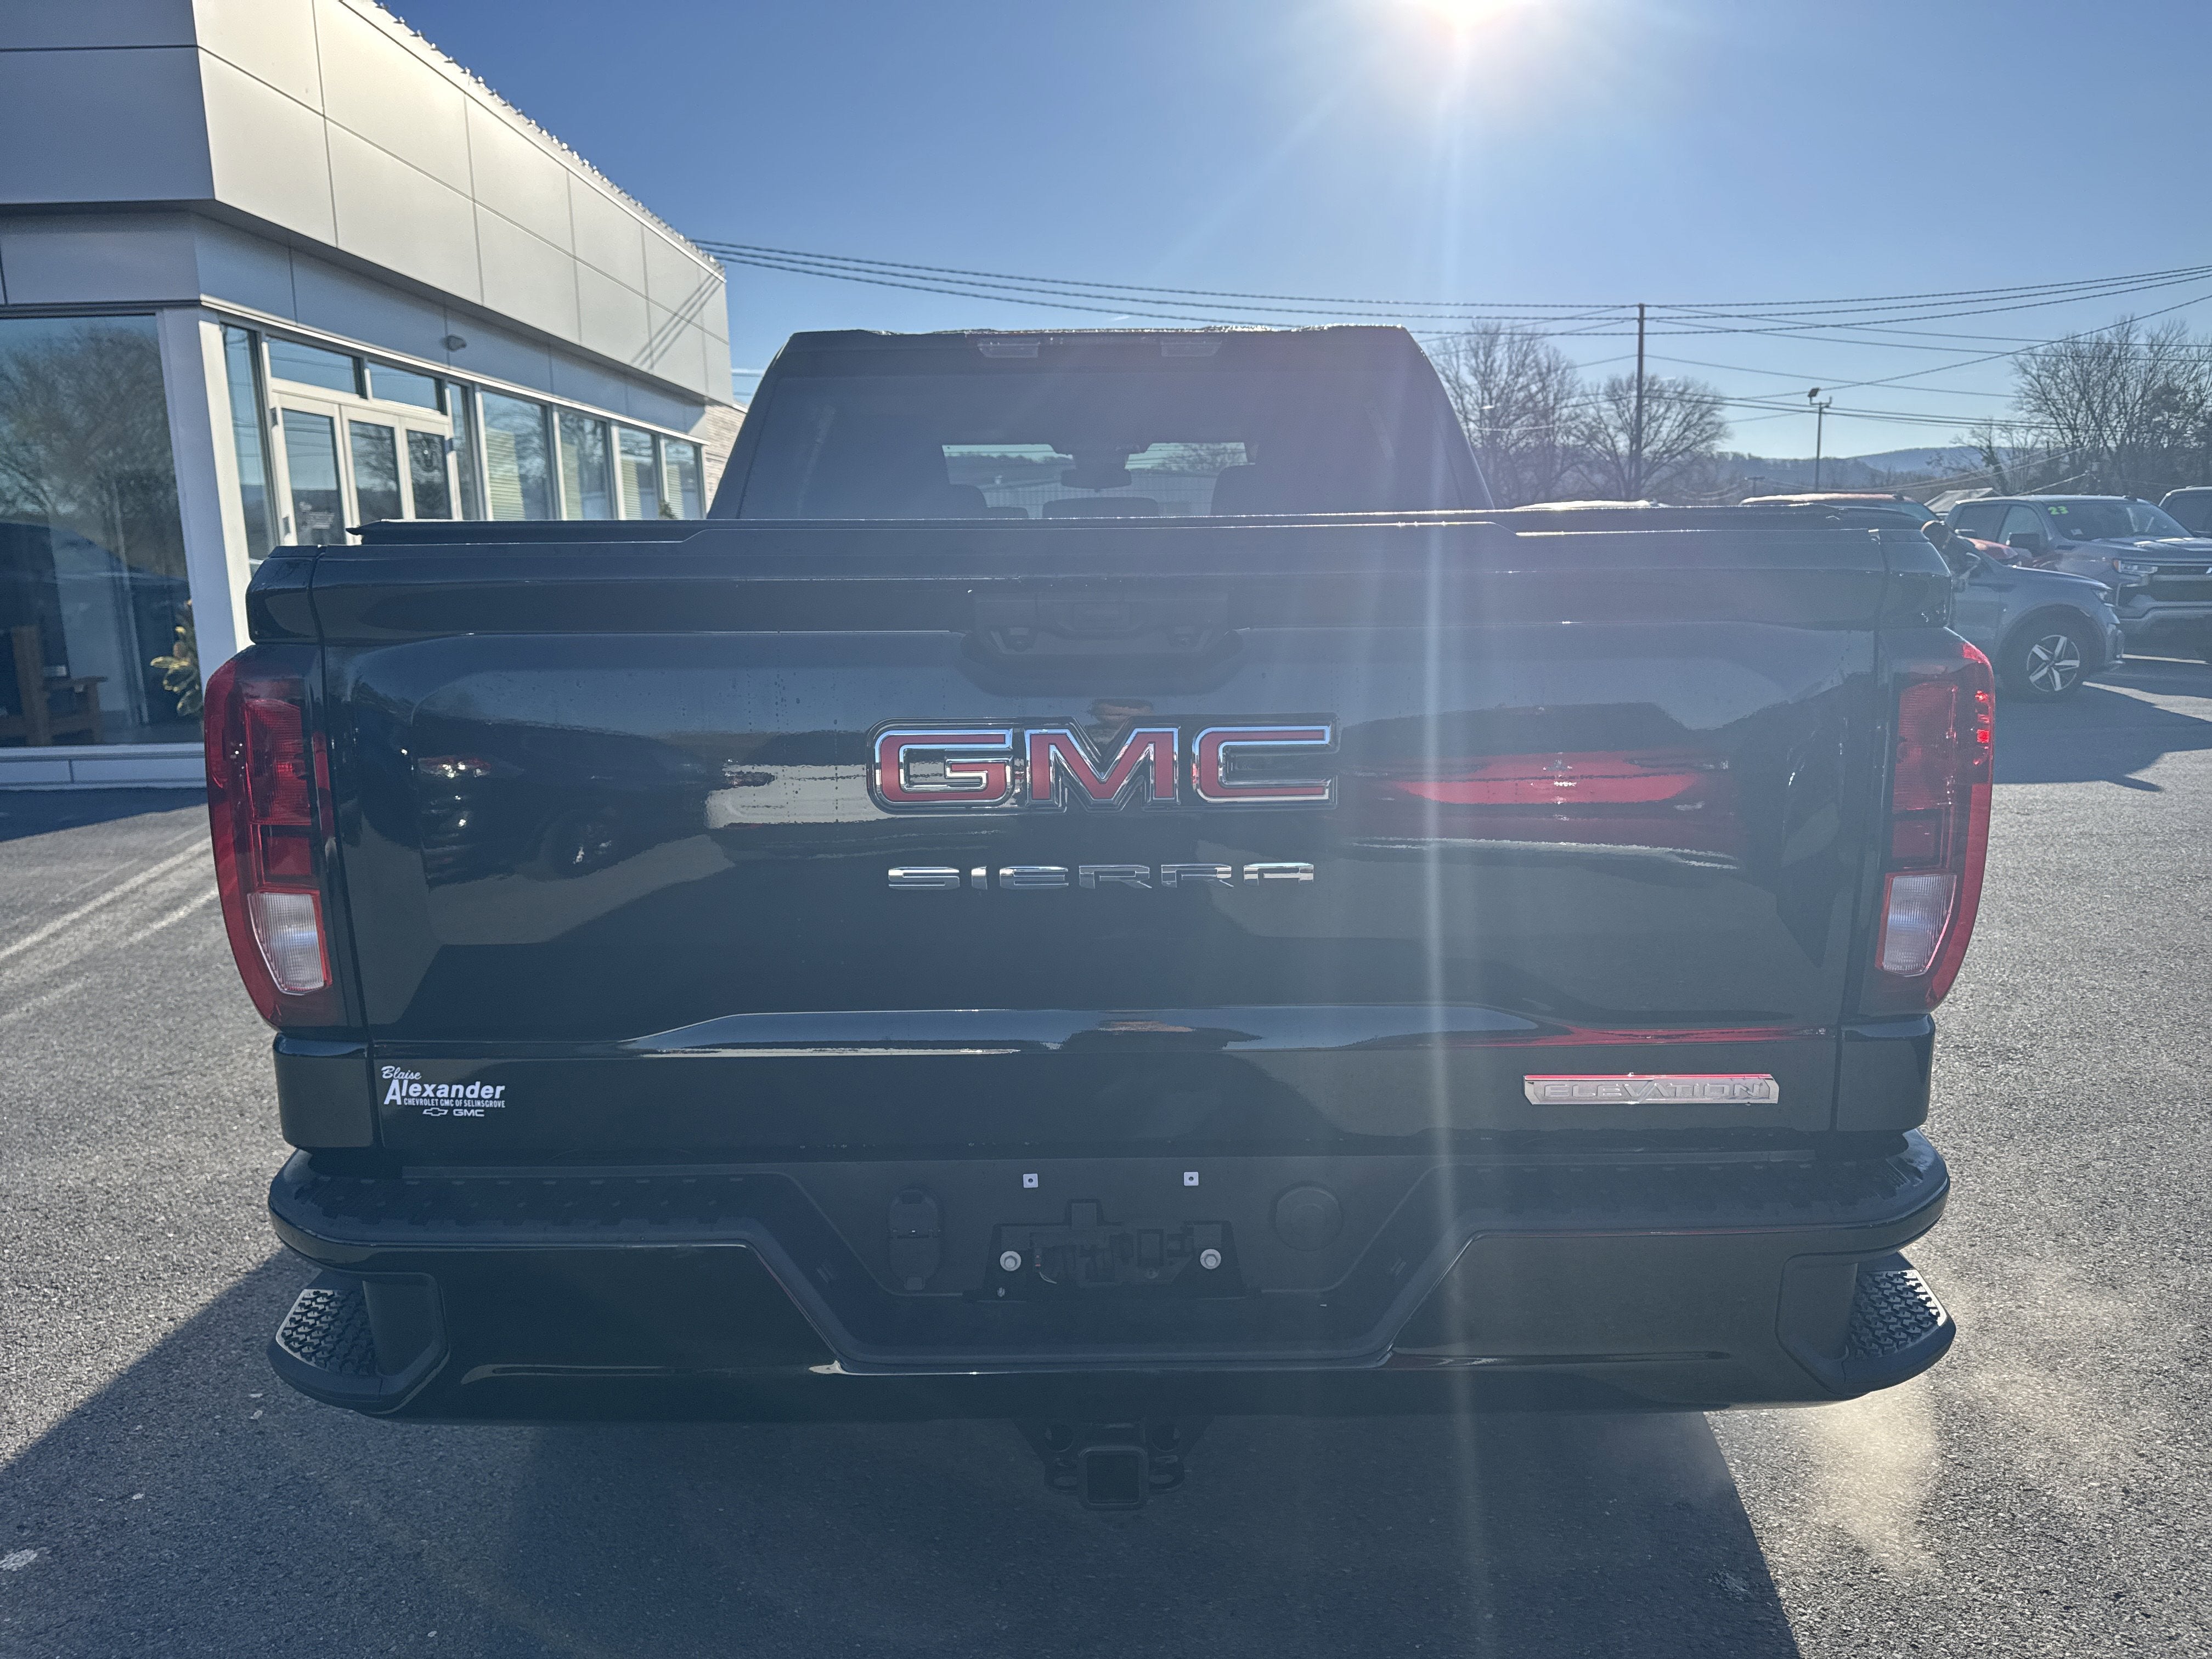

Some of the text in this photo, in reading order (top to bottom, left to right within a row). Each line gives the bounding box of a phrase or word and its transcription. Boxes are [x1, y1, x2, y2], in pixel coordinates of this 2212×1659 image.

[872, 724, 1334, 807] GMC
[888, 862, 1315, 889] SIERRA
[381, 1065, 422, 1080] Blaise
[384, 1079, 505, 1105] Alexander
[1544, 1082, 1763, 1098] ELEVATION
[404, 1098, 506, 1108] CHEVROLET GMC OF SELINSGROVE
[453, 1109, 485, 1117] GMC
